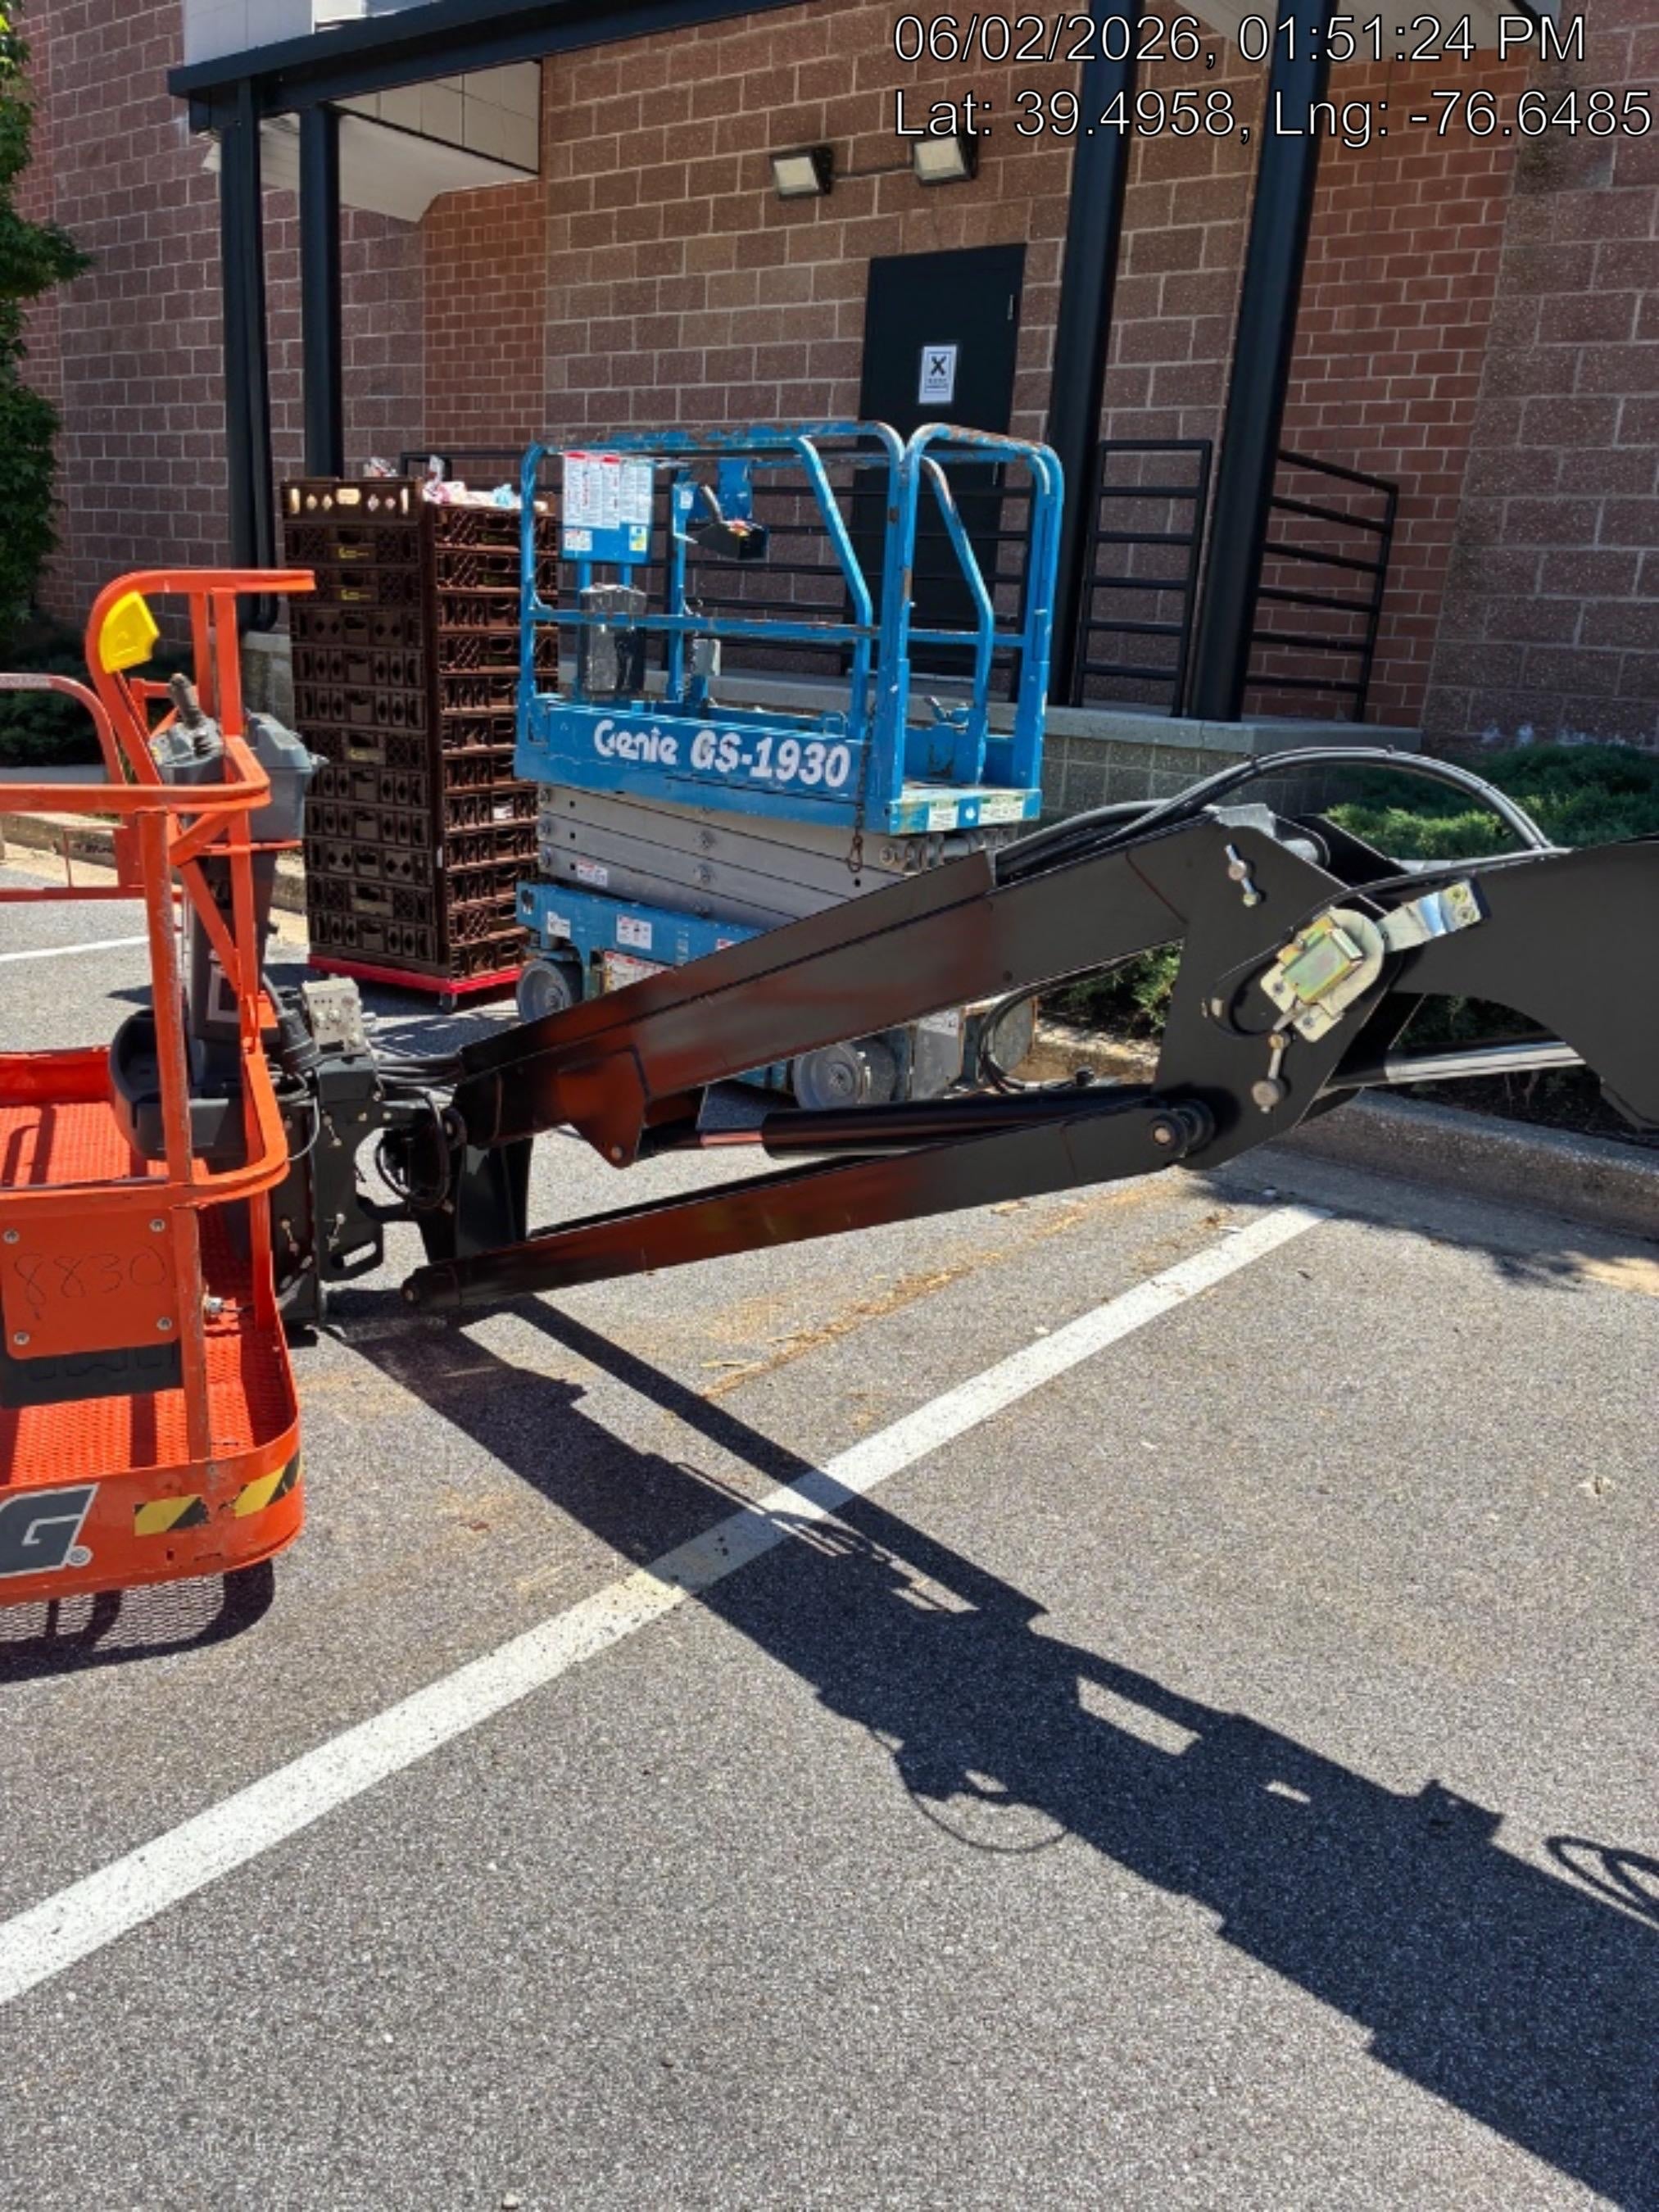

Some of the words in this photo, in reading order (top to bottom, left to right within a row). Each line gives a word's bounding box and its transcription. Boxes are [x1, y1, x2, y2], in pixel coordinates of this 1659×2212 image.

[594, 719, 679, 765] Genie
[690, 729, 850, 787] GS-1930
[13, 1244, 167, 1308] 8830
